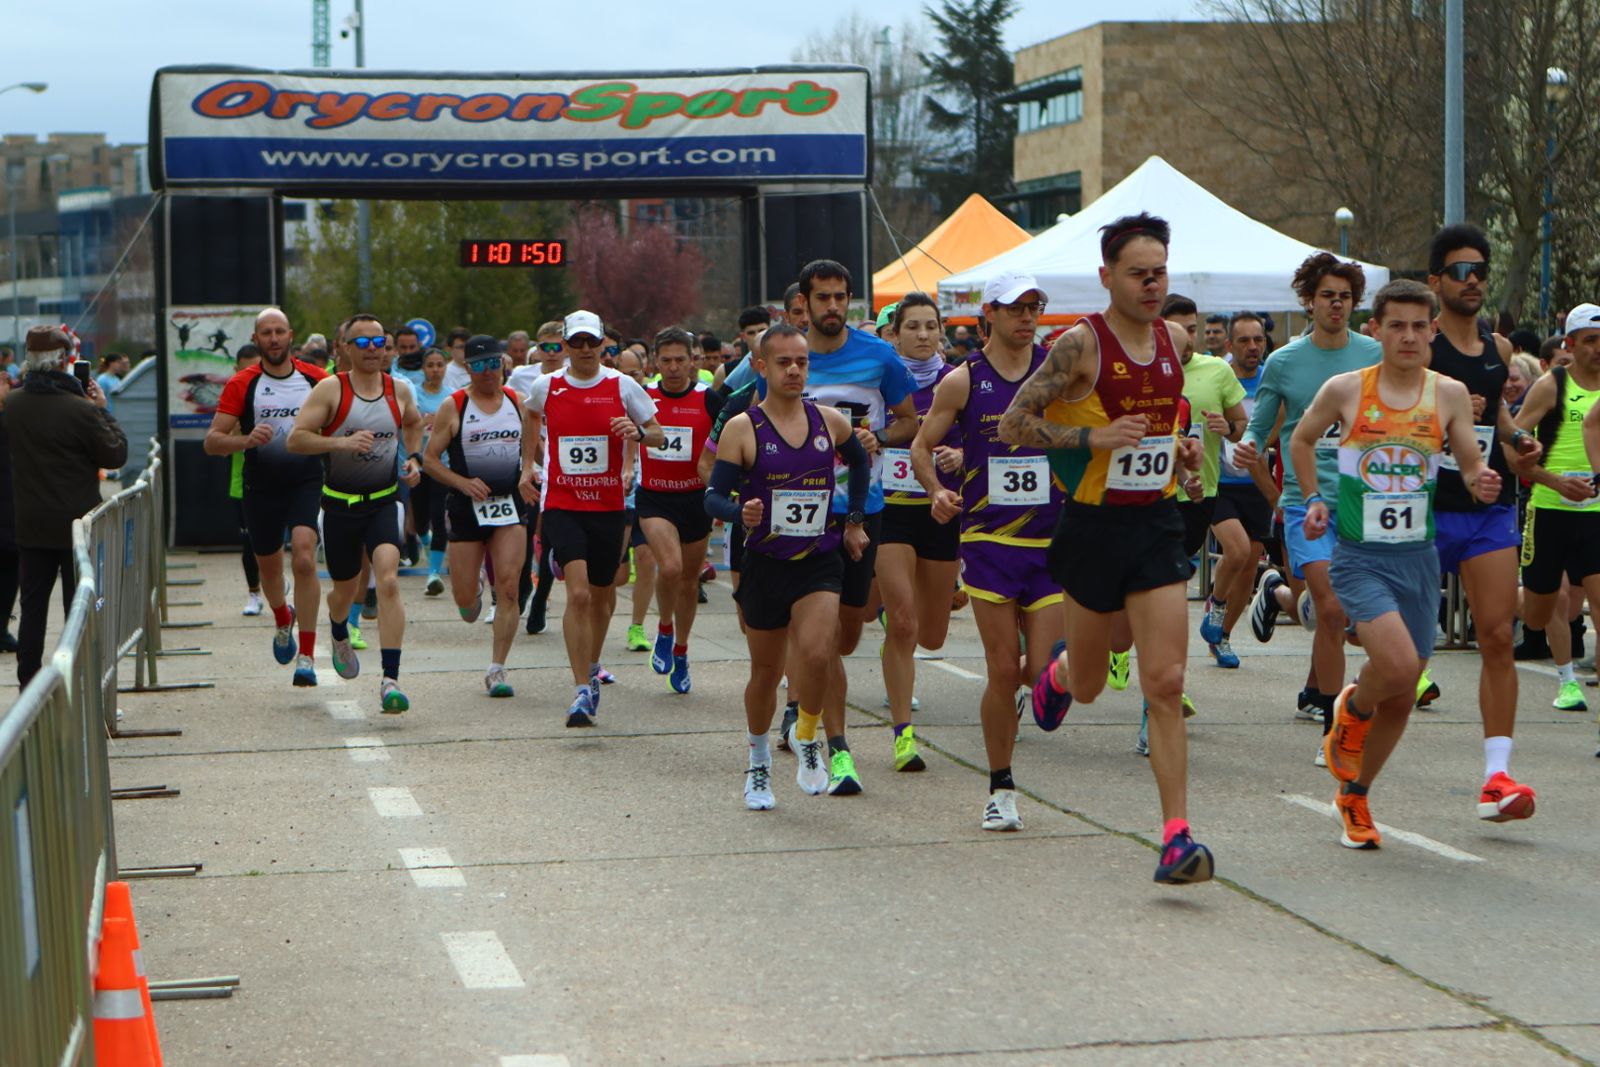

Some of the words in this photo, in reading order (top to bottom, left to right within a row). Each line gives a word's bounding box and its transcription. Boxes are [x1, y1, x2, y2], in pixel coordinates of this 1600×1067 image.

[261, 142, 777, 173] www.orycronsport.com
[260, 407, 300, 418] 3730
[344, 430, 394, 439] 300
[470, 429, 519, 442] 37300
[569, 446, 598, 464] 93
[1117, 451, 1169, 477] 130
[893, 460, 913, 479] 3
[1003, 470, 1037, 492] 38
[479, 503, 513, 519] 126
[785, 503, 819, 524] 37
[1380, 507, 1412, 530] 61
